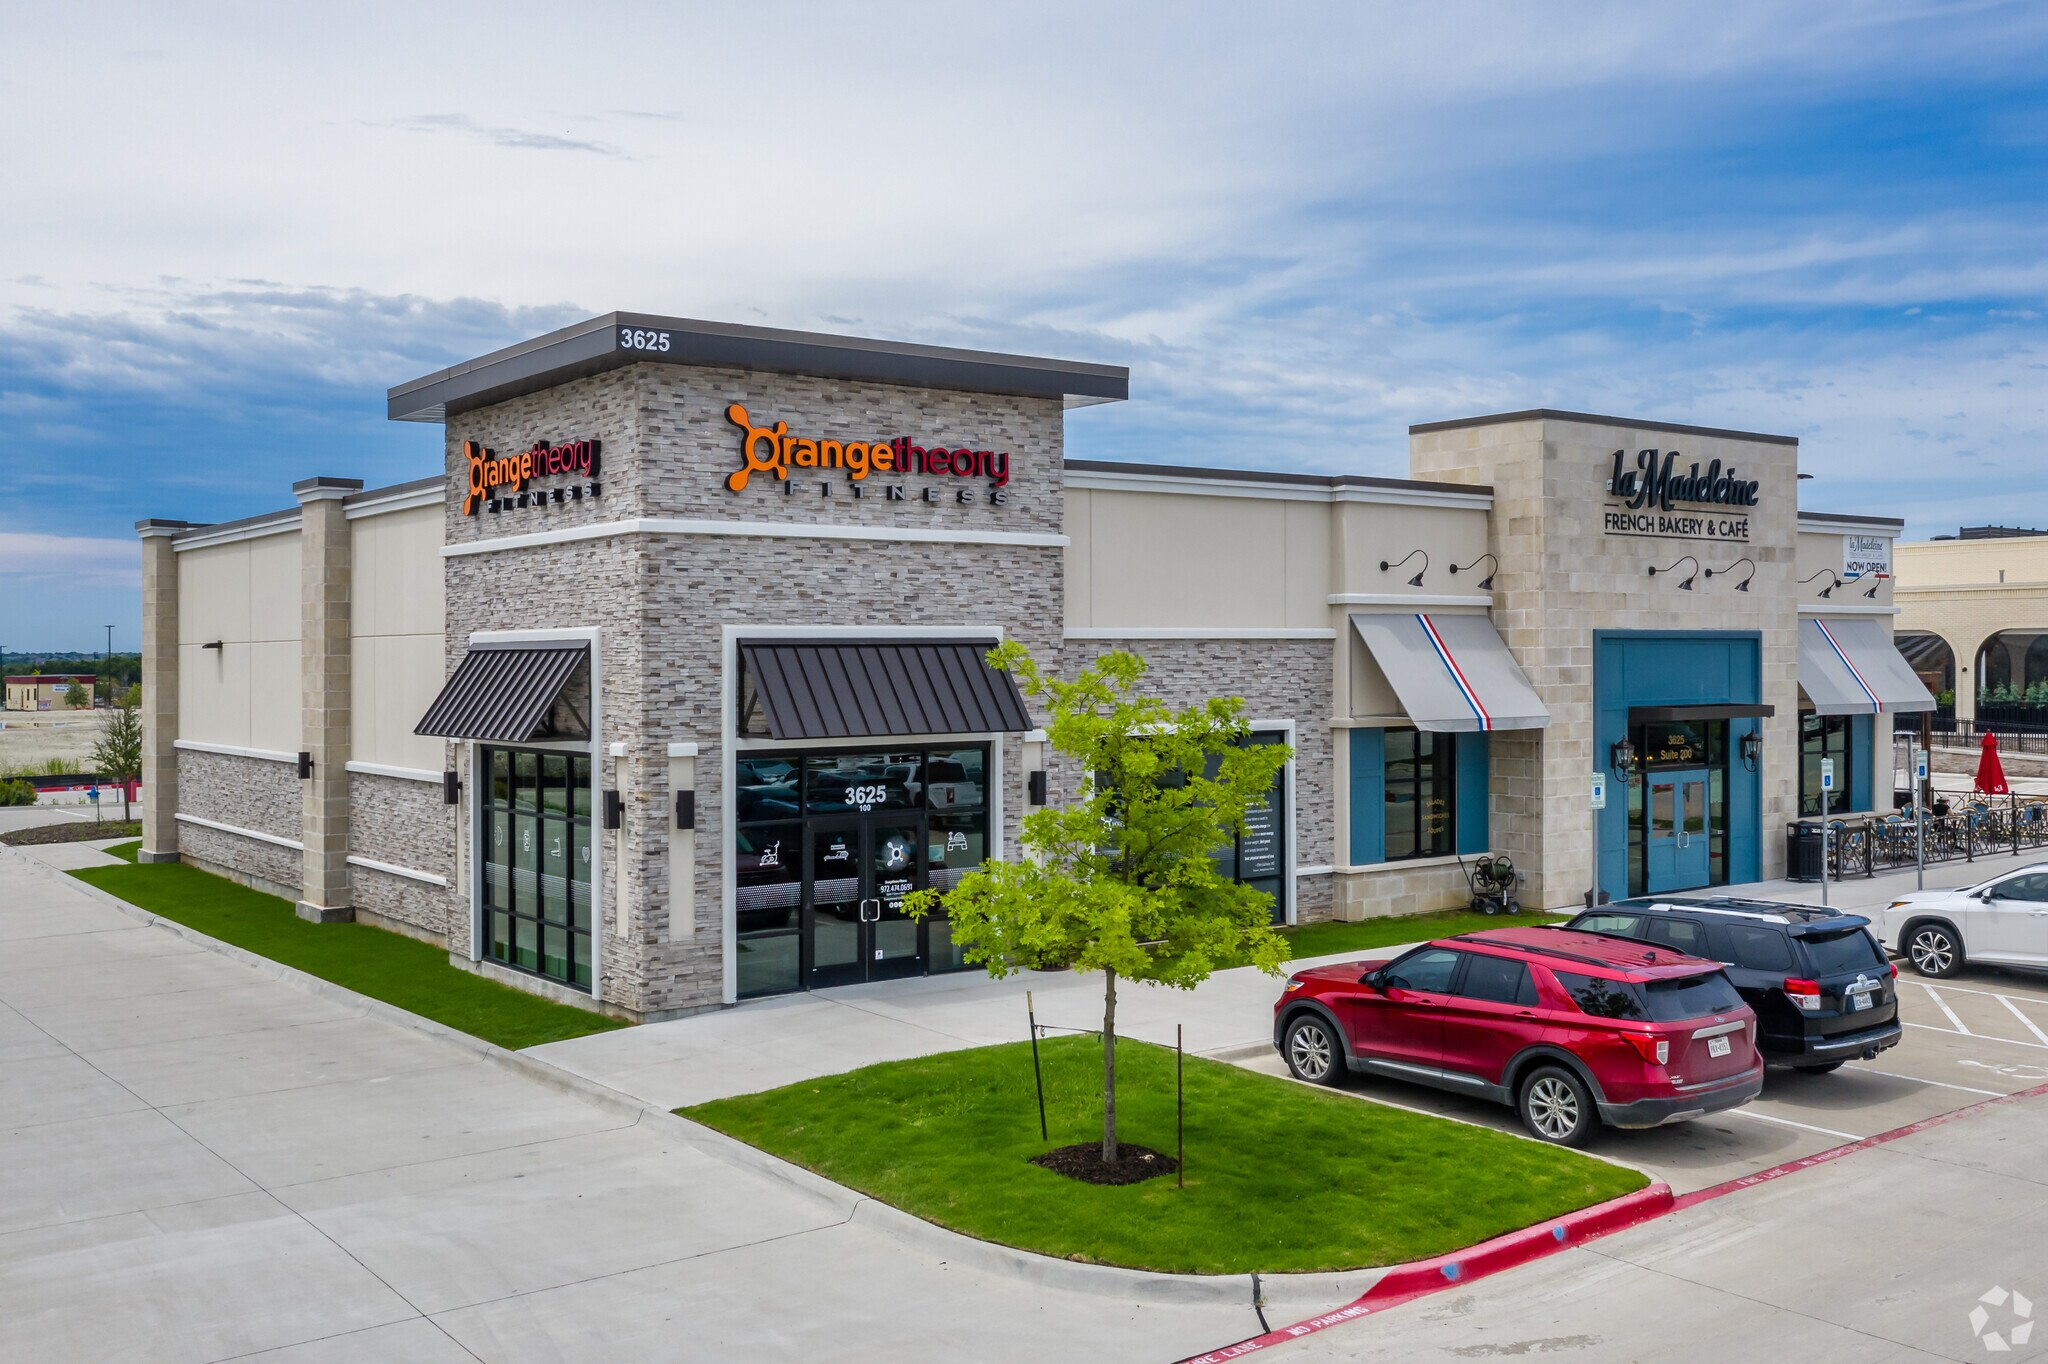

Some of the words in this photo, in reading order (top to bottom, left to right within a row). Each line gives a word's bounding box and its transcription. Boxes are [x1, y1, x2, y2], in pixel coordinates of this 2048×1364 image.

[621, 328, 670, 352] 3625
[1625, 448, 1760, 512] Madeleine
[487, 482, 593, 511] FITNESS
[785, 480, 1009, 506] FITNESS
[1604, 512, 1655, 533] FRENCH
[1658, 516, 1704, 536] BAKERY
[1707, 519, 1716, 536] &
[1719, 518, 1749, 538] CAFÉ
[1846, 561, 1865, 572] NOW
[1866, 562, 1887, 573] OPEN!
[1668, 735, 1685, 745] 3625
[1660, 749, 1679, 760] Suite
[1680, 749, 1692, 760] 200
[845, 785, 887, 805] 3625
[859, 804, 872, 812] 100
[1220, 1341, 1263, 1357] LANE
[1285, 1325, 1311, 1337] NO
[1309, 1305, 1370, 1328] PARKING
